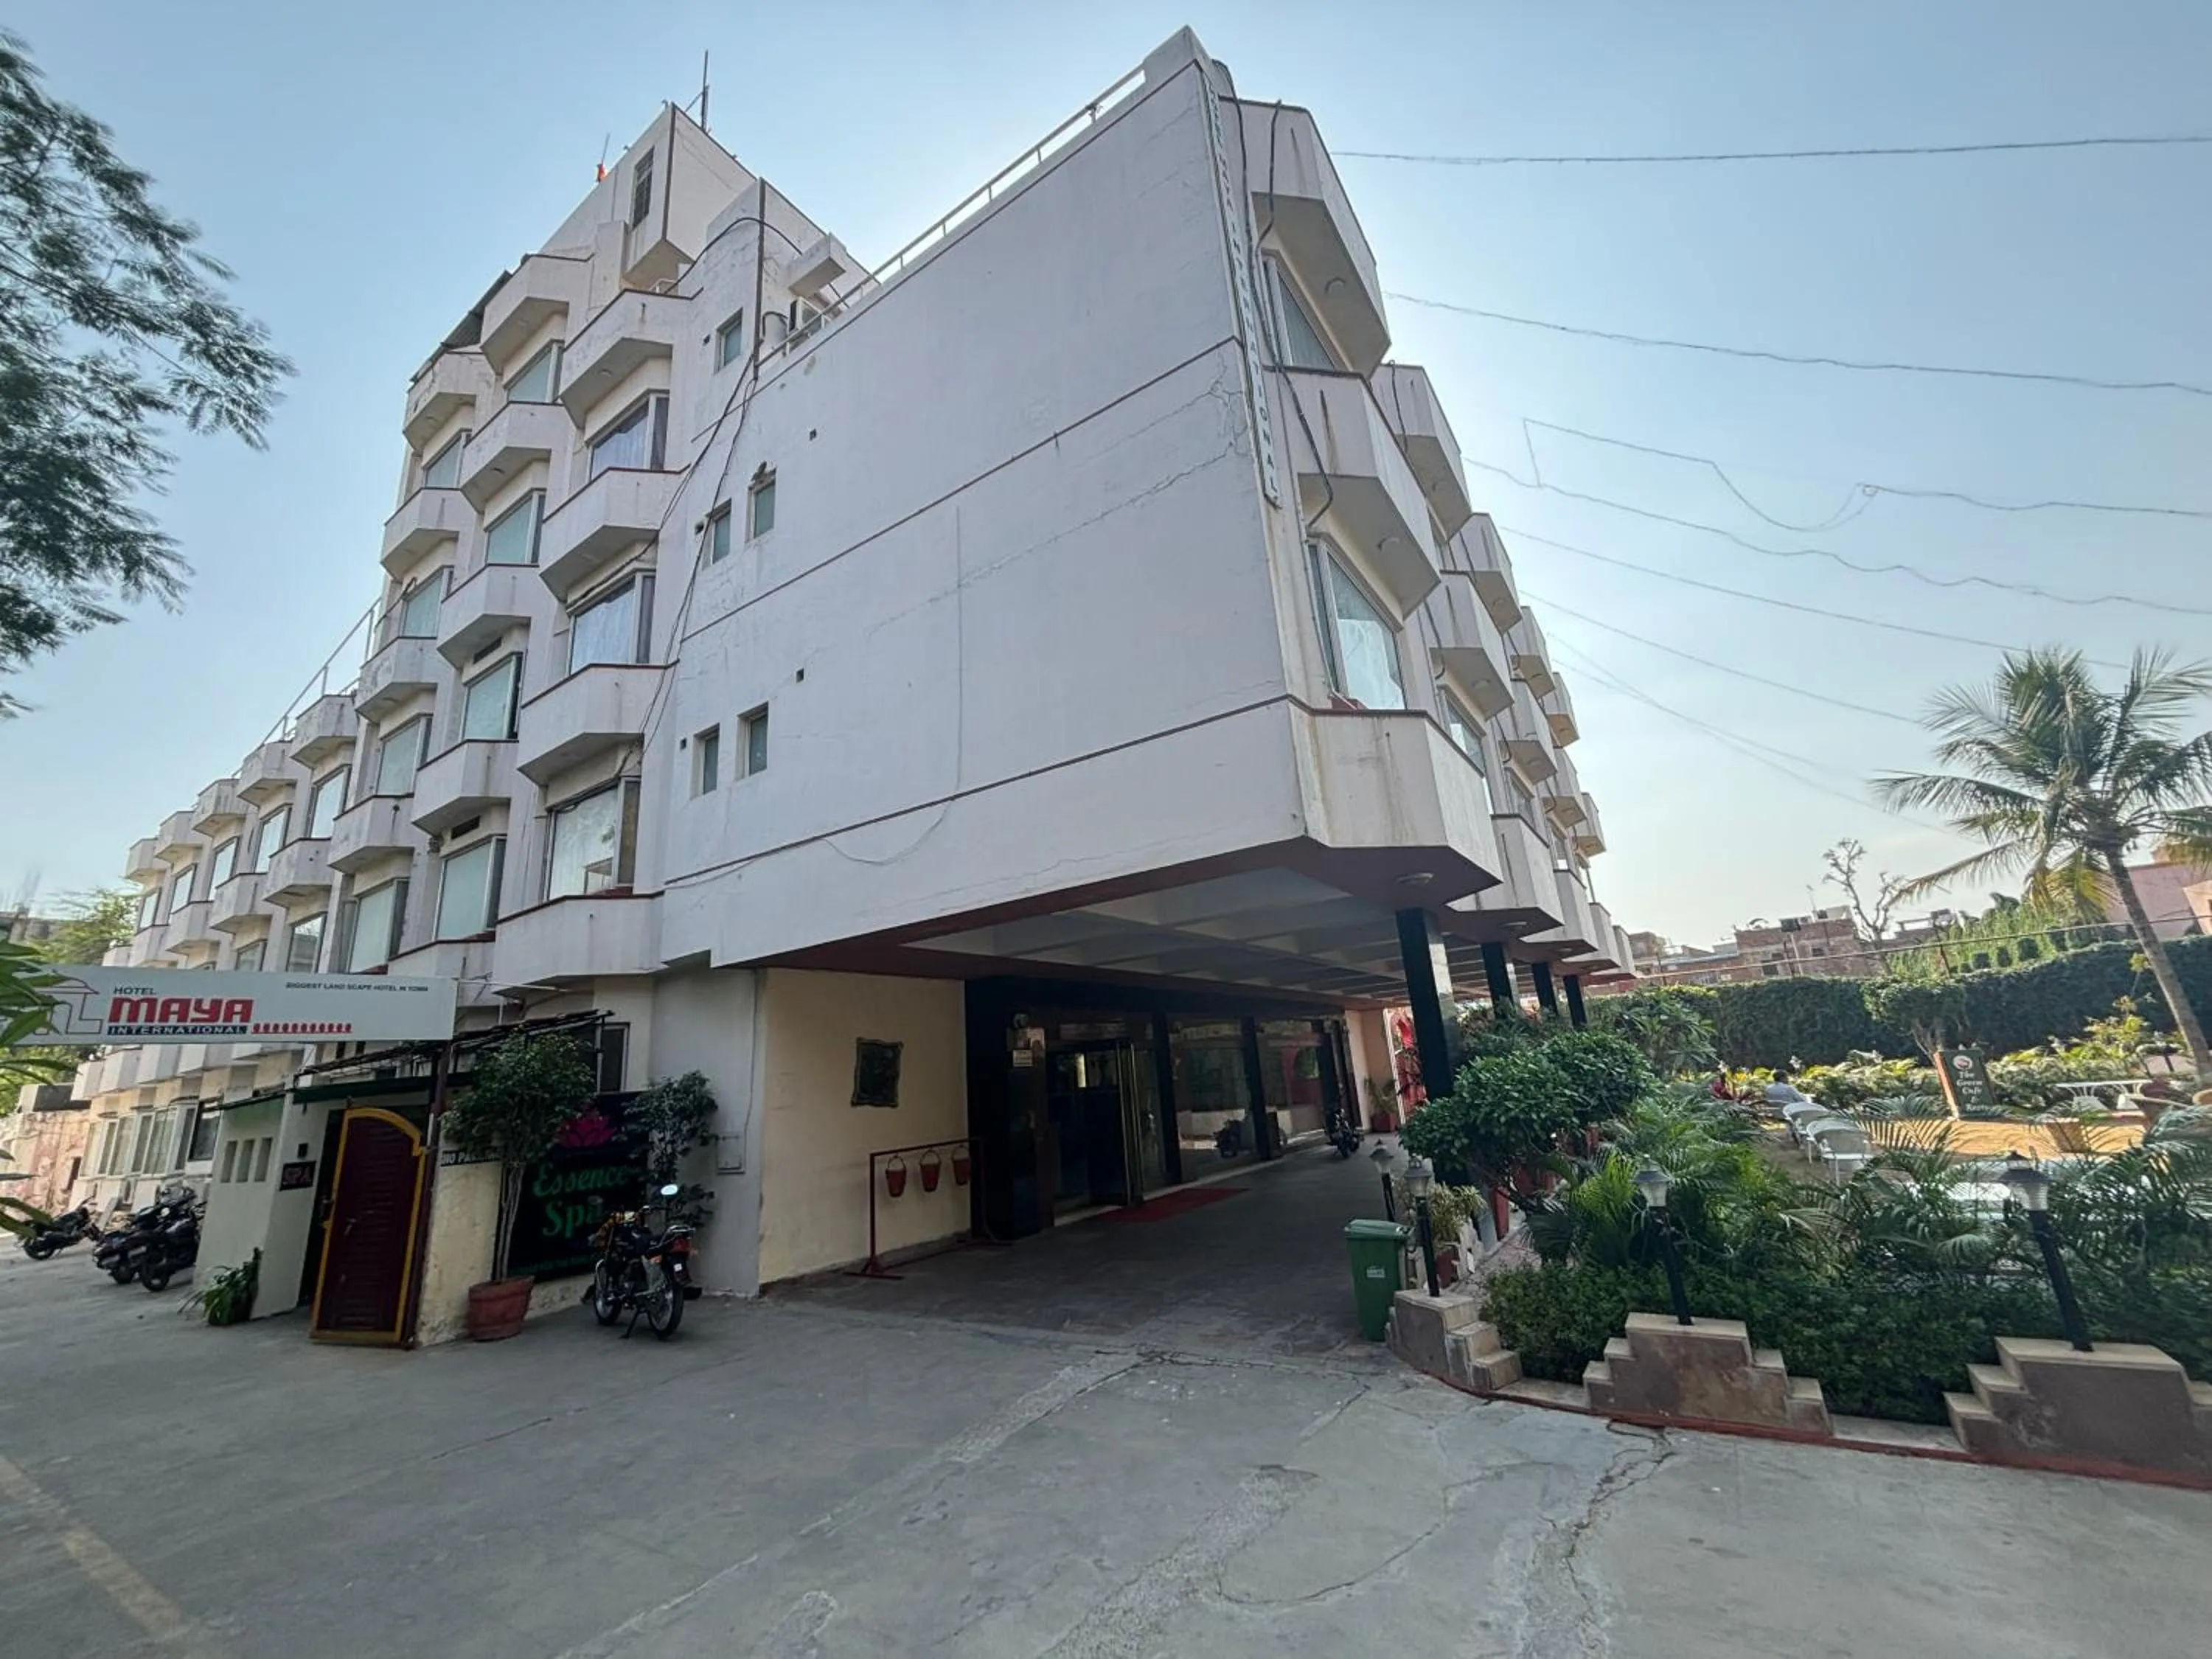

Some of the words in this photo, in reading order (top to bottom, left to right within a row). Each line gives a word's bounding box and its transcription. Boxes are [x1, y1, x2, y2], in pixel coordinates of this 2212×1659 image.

[113, 987, 156, 995] HOTEL
[108, 997, 254, 1024] MAYA
[110, 1025, 245, 1035] INTERNATIONAL
